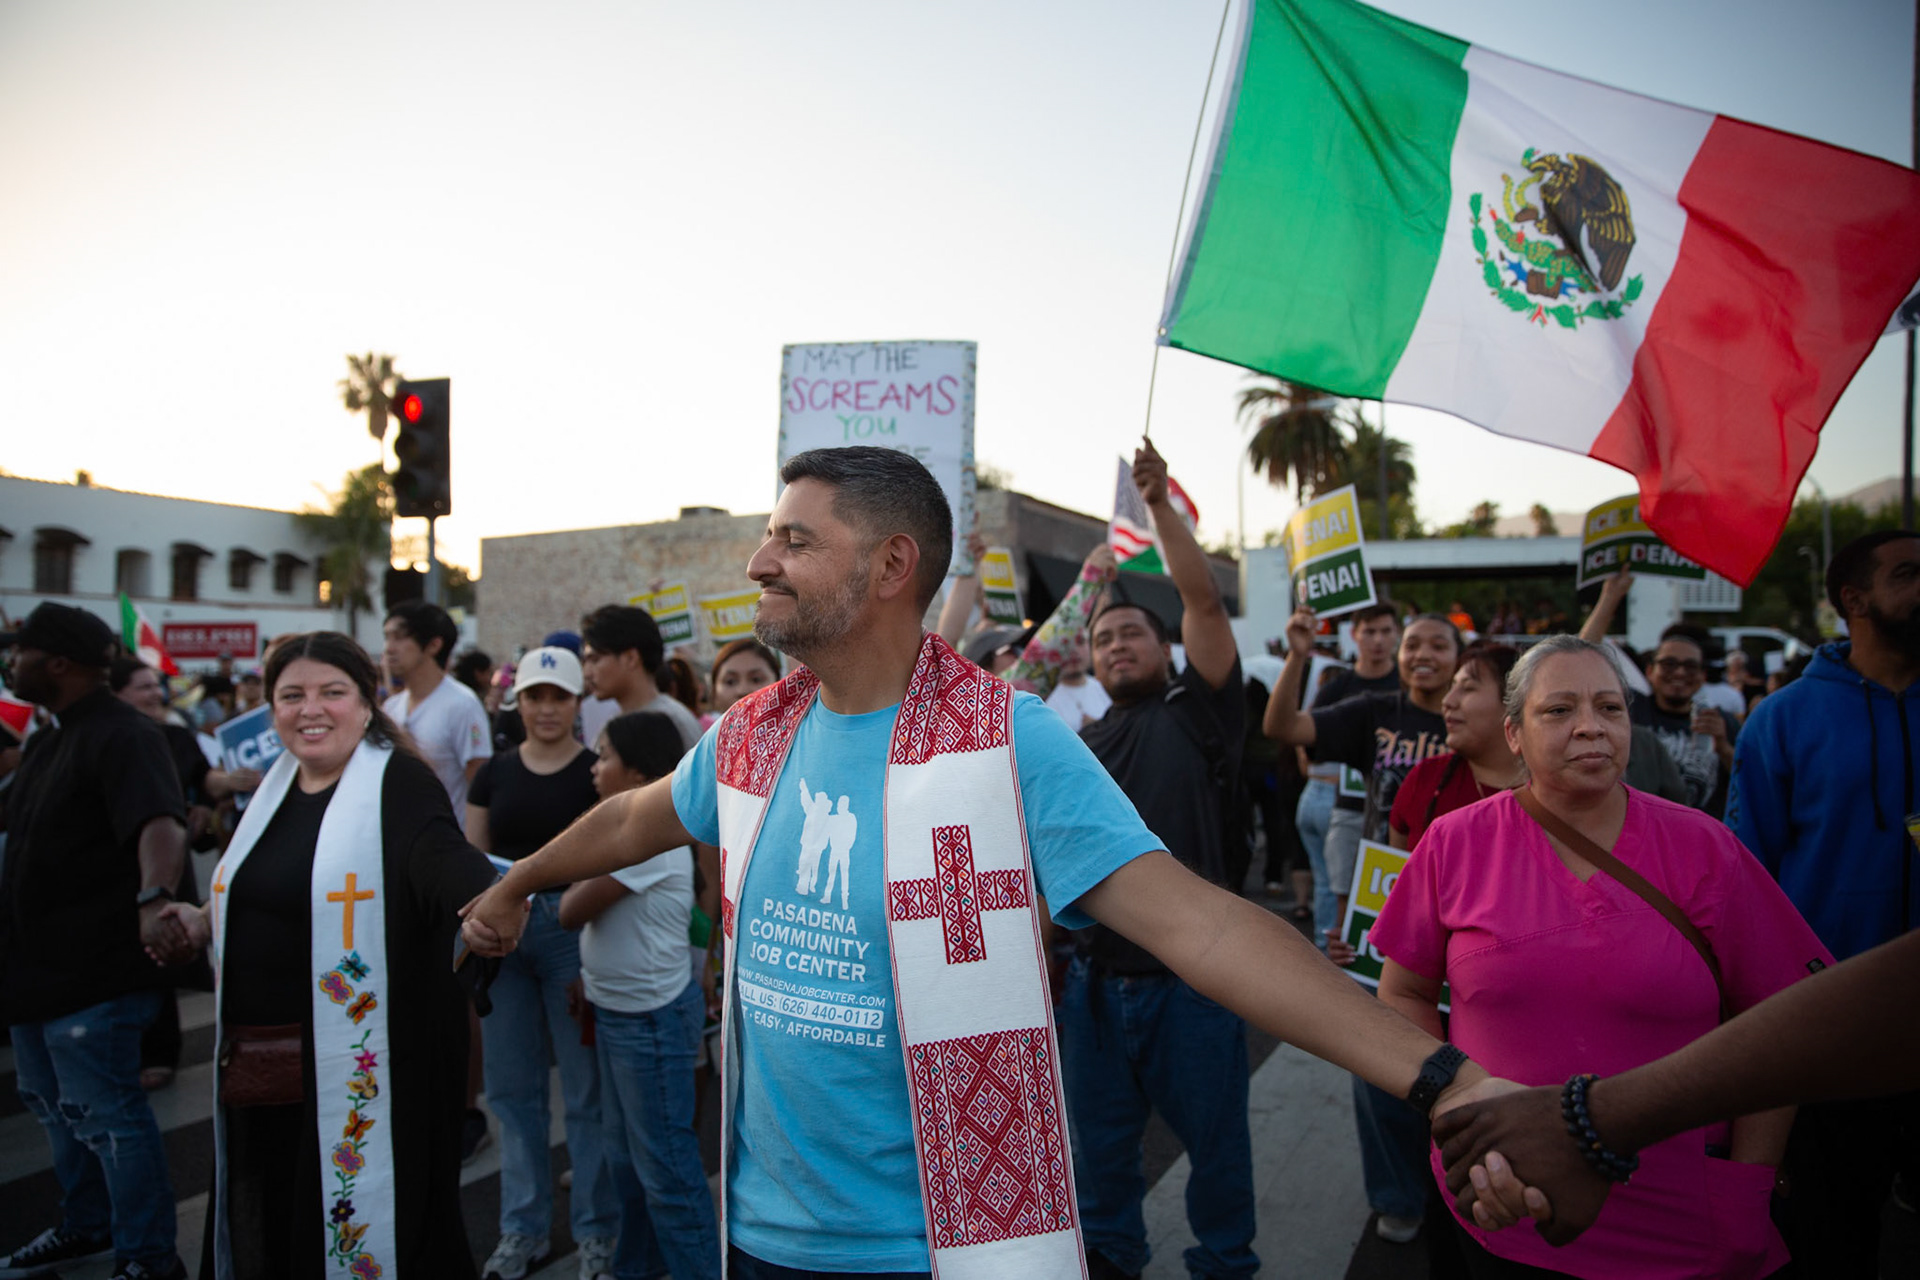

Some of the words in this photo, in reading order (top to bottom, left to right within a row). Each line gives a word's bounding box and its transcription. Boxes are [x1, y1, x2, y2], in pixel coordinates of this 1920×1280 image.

[802, 348, 864, 374] MAY
[871, 346, 919, 373] THE
[788, 375, 959, 416] SCREAMS
[836, 414, 897, 440] YOU
[1585, 545, 1618, 572] ICE
[1631, 543, 1700, 569] DENA
[227, 727, 283, 771] ICE
[1370, 867, 1400, 898] IC
[763, 898, 858, 936] PASADENA
[750, 918, 870, 960] COMMUNITY
[750, 941, 782, 966] JOB
[785, 951, 866, 983] CENTER
[740, 984, 756, 1001] ALL
[760, 992, 777, 1007] US:
[779, 997, 808, 1017] (626)
[812, 1004, 880, 1026] 440-0112
[754, 1010, 782, 1031] EASY
[786, 1021, 886, 1048] AFFORDABLE
